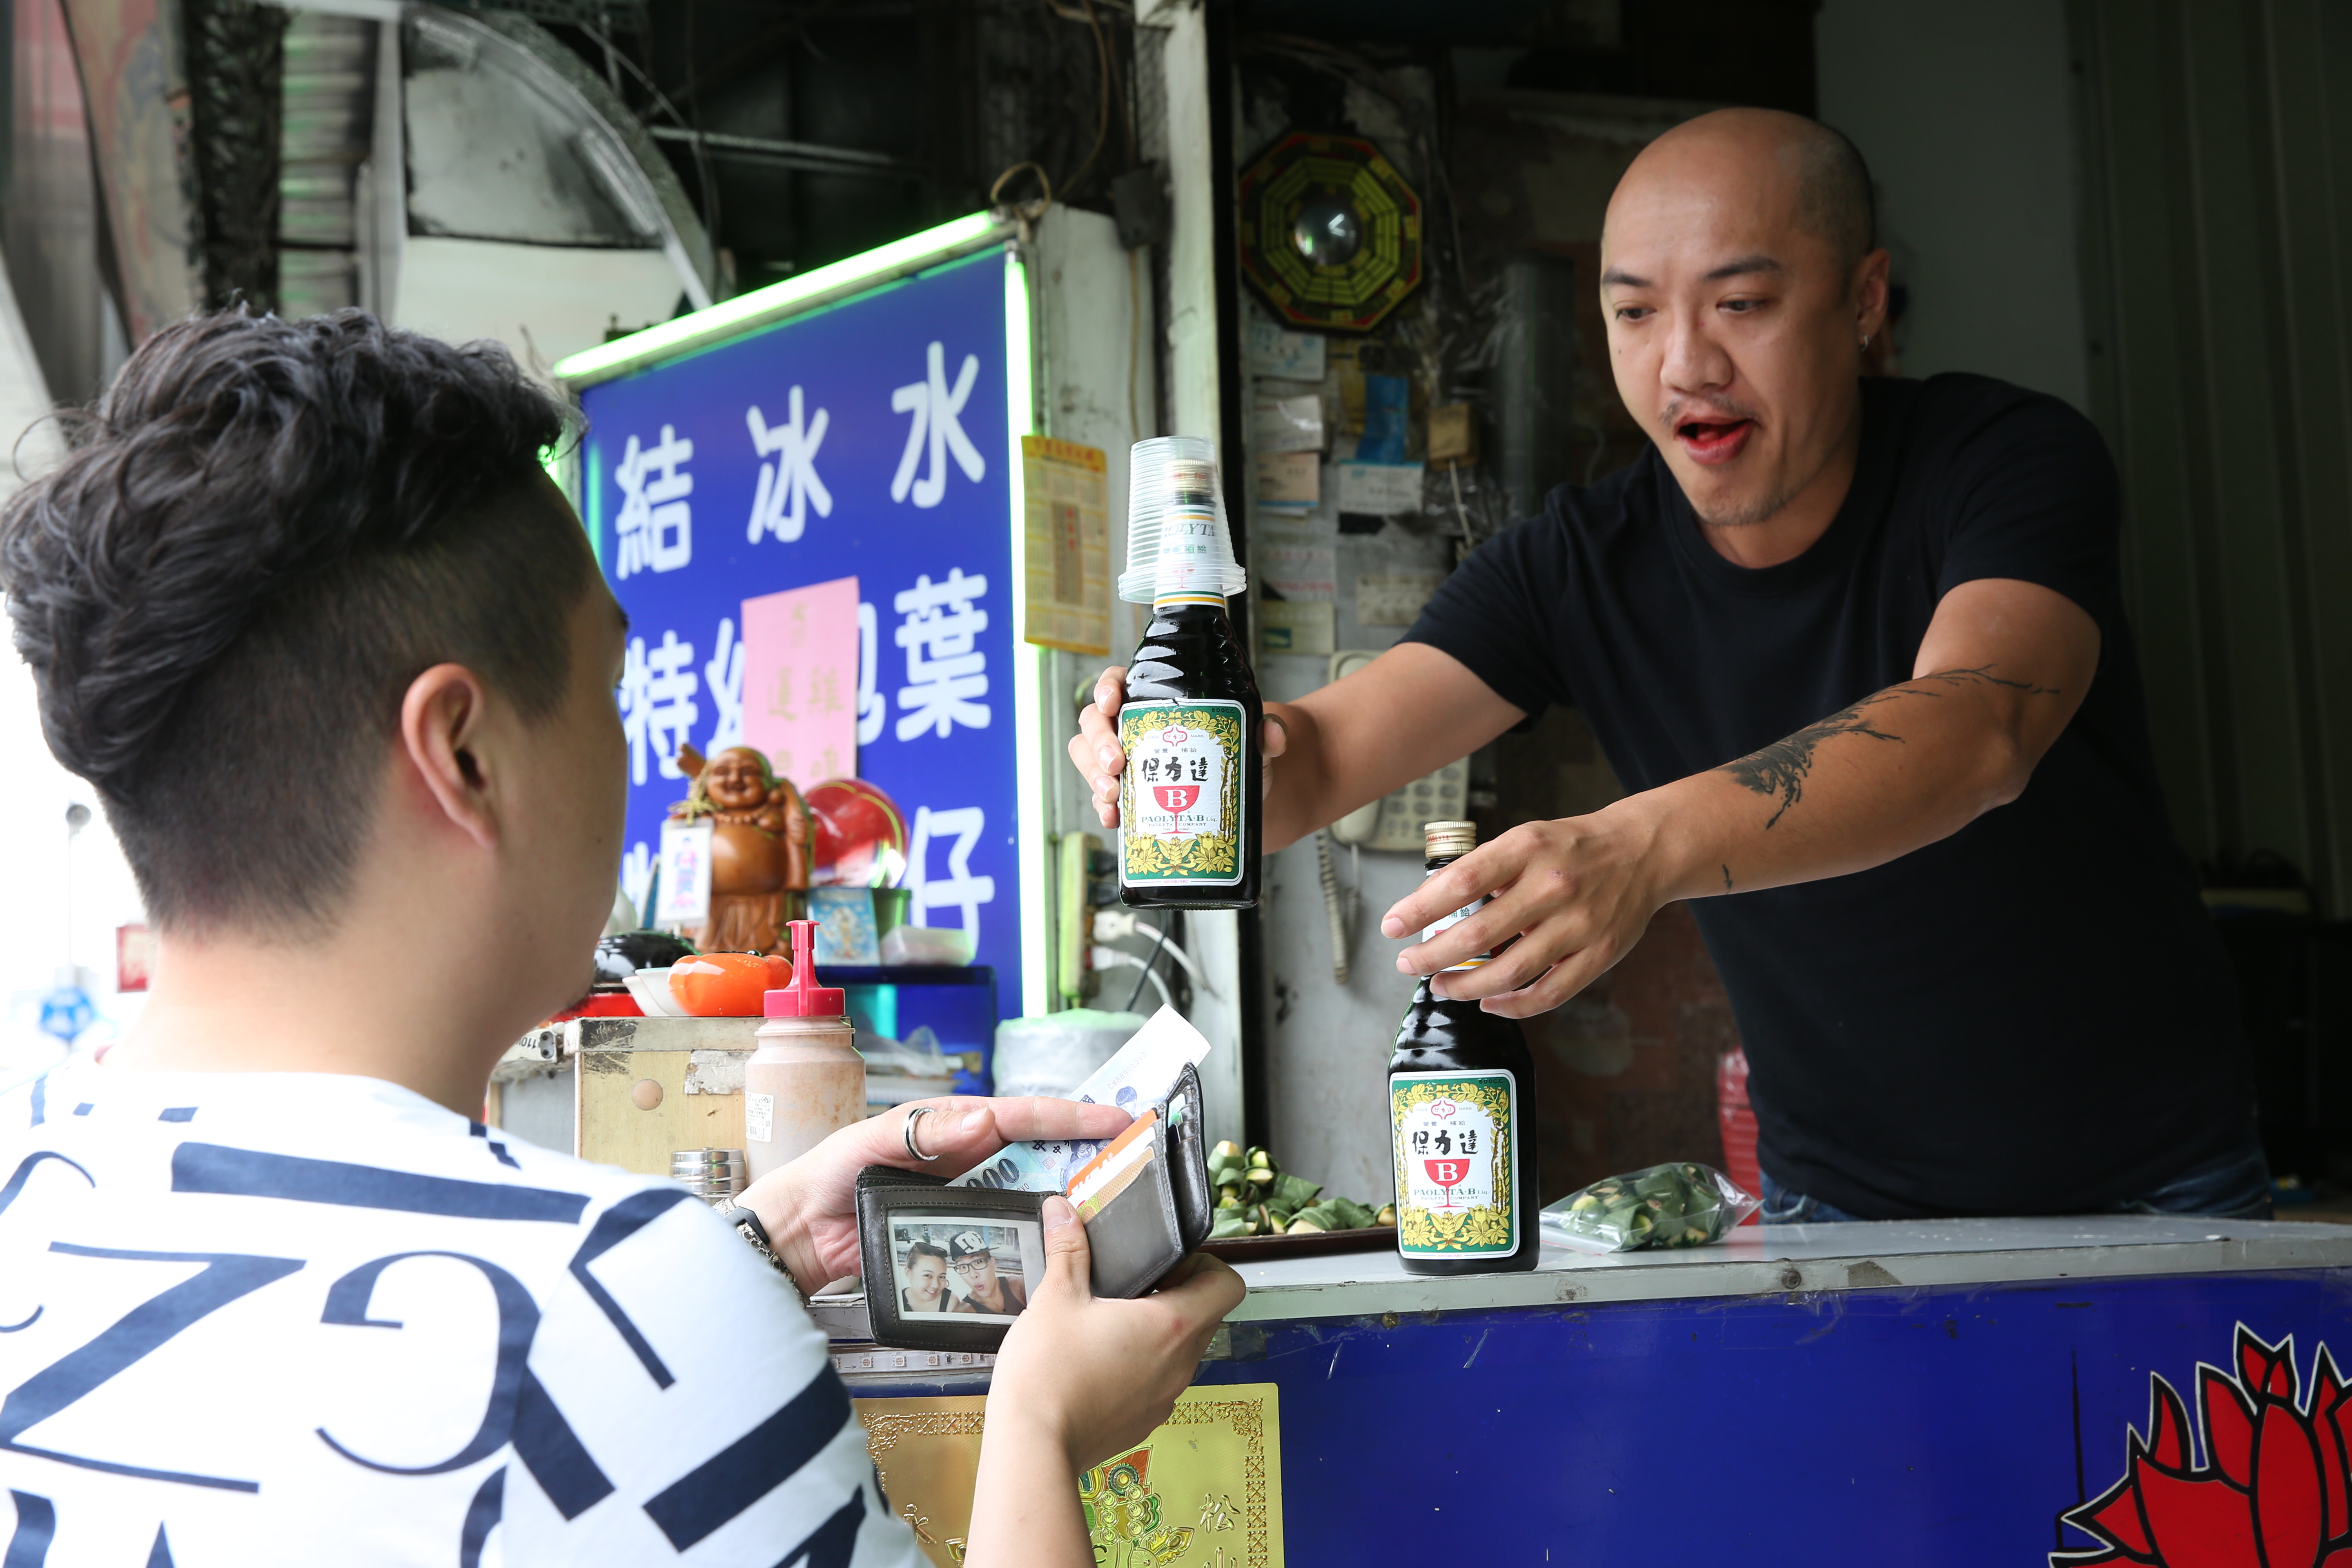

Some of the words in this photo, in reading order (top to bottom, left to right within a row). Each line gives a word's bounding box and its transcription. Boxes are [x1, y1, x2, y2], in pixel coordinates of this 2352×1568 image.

[1142, 756, 1209, 782] 保力達
[1165, 789, 1188, 808] B
[1412, 1129, 1479, 1155] 保力達
[1435, 1163, 1458, 1181] B
